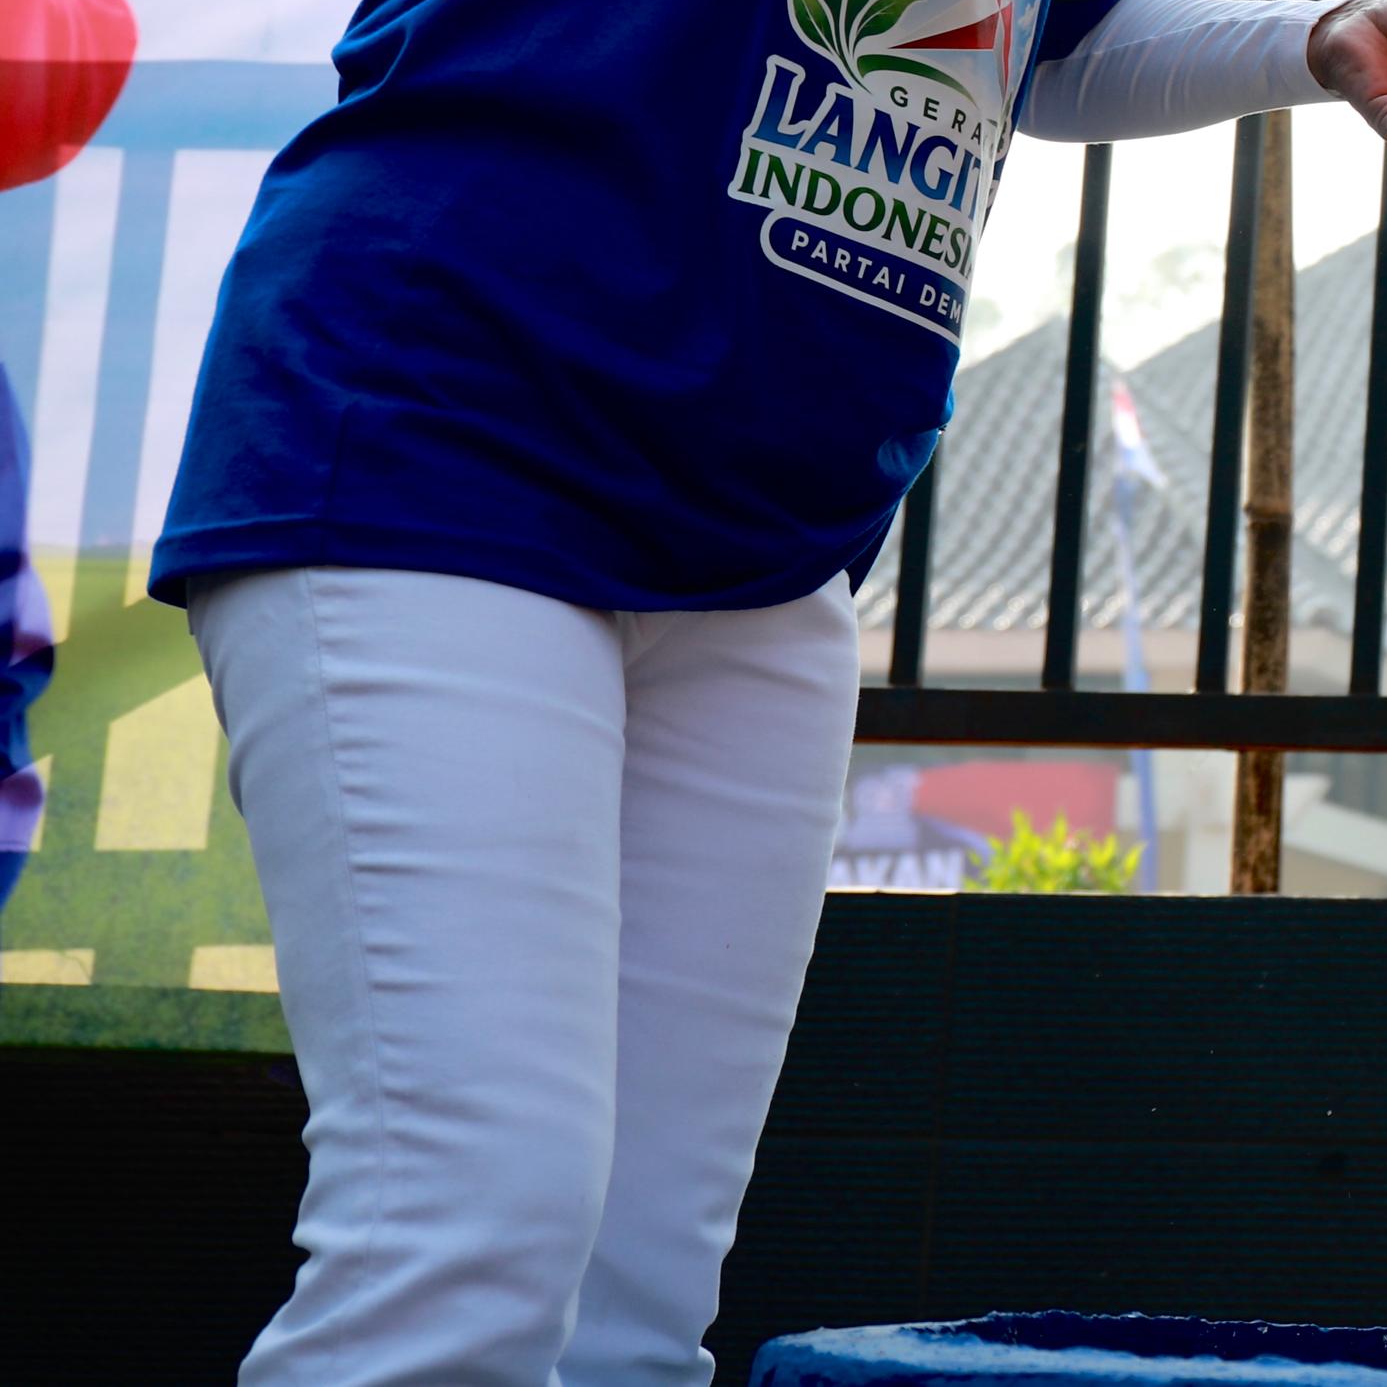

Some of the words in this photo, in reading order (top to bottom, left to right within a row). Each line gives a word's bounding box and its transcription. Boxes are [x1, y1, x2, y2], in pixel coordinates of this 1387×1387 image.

[889, 85, 1002, 153] GERA
[738, 147, 973, 281] INDONESI
[790, 229, 906, 295] PARTAI
[919, 284, 963, 324] DEM
